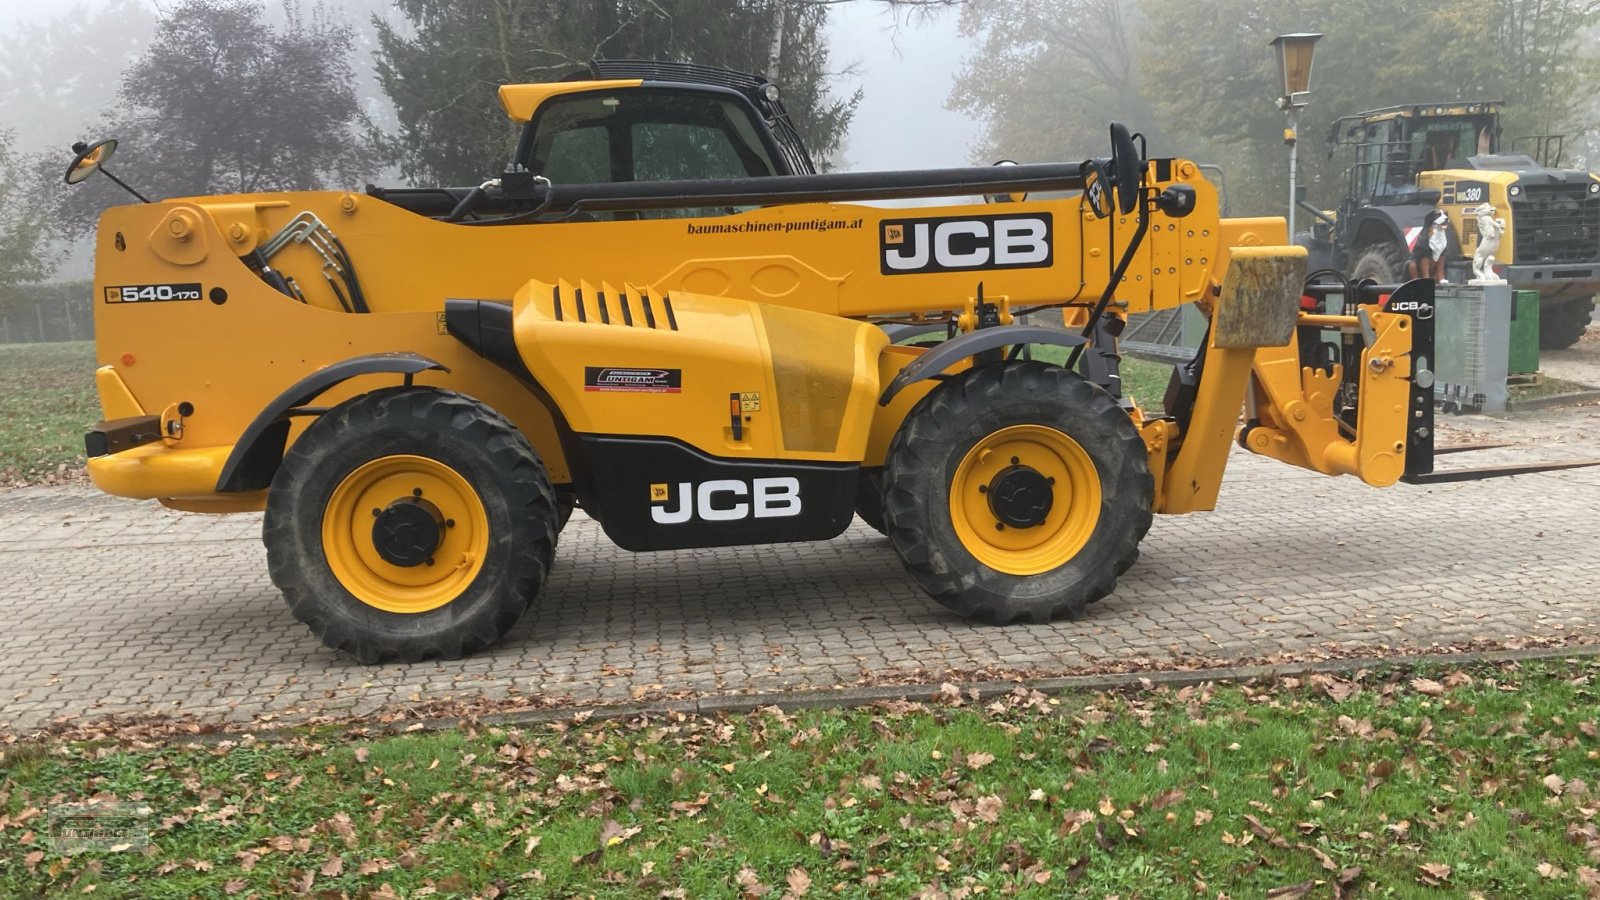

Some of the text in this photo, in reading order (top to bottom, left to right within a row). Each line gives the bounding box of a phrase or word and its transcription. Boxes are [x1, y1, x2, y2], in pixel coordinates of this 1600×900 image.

[687, 218, 863, 234] baumaschinen-puntigam.at
[885, 218, 1049, 269] JCB
[122, 286, 199, 302] 540-170
[1391, 301, 1418, 311] JCB
[650, 476, 802, 524] JCB
